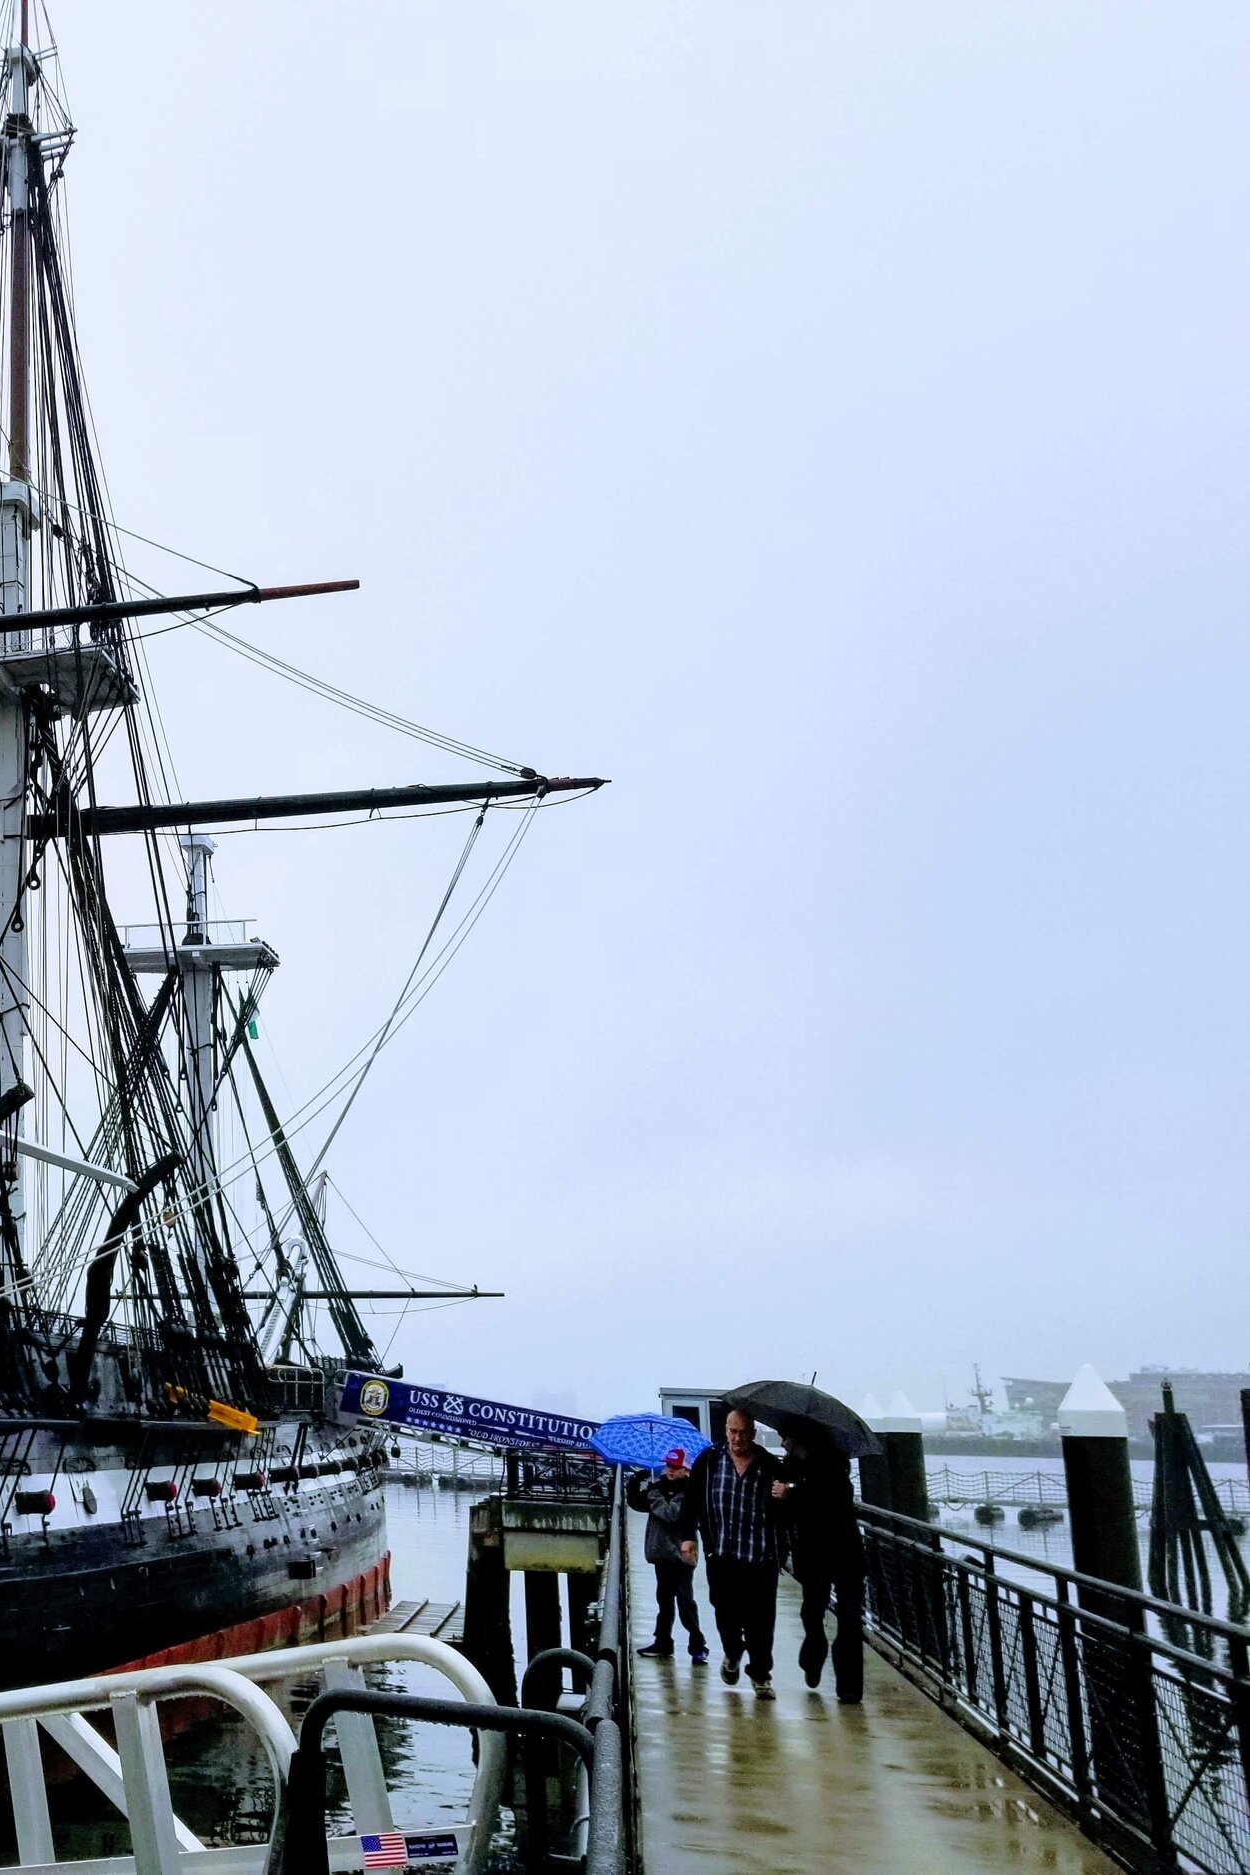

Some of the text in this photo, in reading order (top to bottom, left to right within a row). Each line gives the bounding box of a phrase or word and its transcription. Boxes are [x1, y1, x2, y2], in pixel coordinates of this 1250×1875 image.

[408, 1406, 431, 1416] OLDEST
[431, 1411, 477, 1426] COMMISSIONED
[410, 1390, 439, 1408] USS
[468, 1403, 599, 1440] CONSTITUTIO
